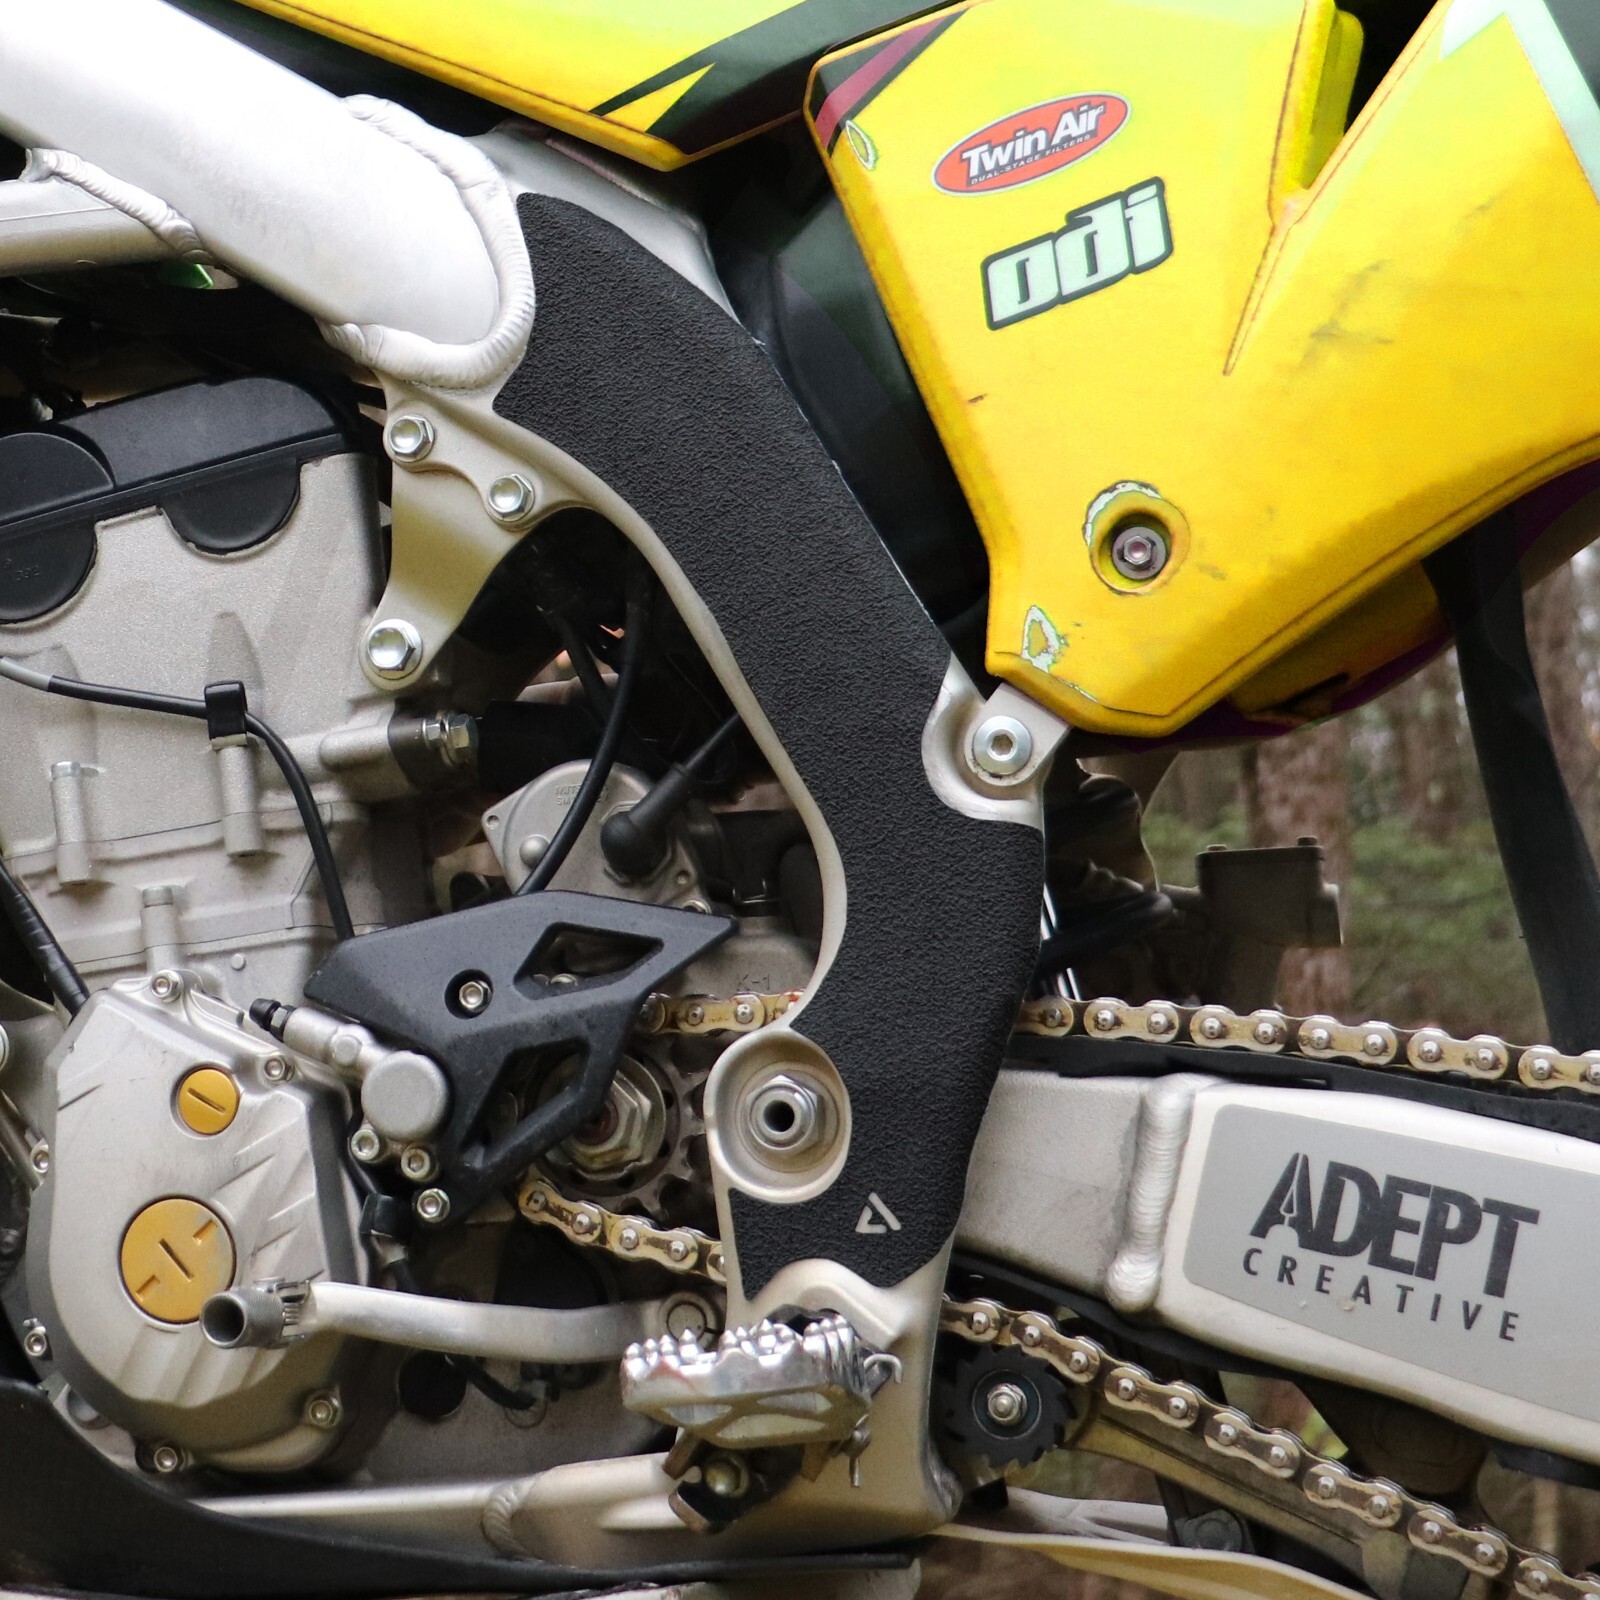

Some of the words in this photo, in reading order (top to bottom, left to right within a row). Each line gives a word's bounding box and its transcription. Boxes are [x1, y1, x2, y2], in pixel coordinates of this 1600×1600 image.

[961, 128, 1046, 179] Twin
[1050, 103, 1105, 146] Air
[971, 154, 1041, 185] DUAL-STAGE
[1045, 134, 1091, 157] FILTERS
[982, 178, 1172, 329] odi
[1250, 1152, 1540, 1298] ADEPT
[1243, 1248, 1519, 1342] CREATIVE
